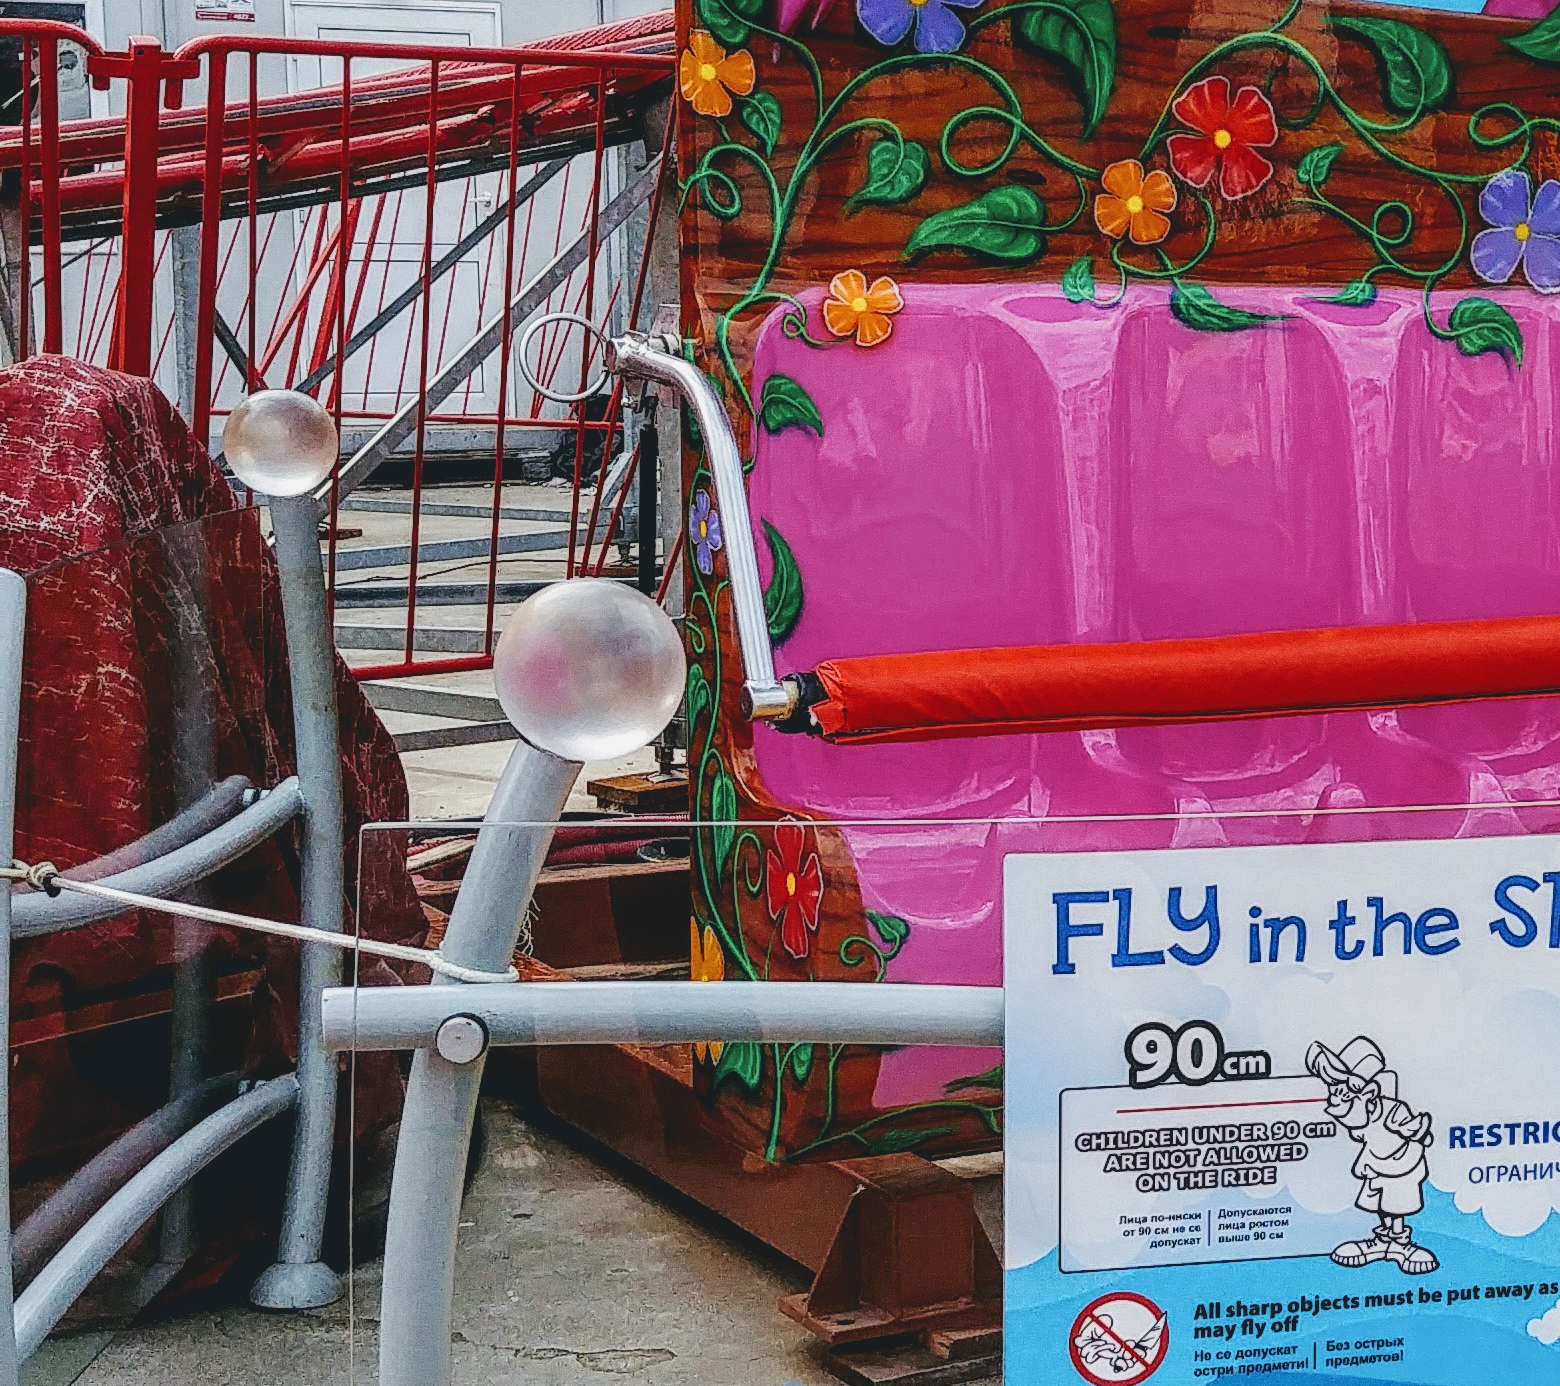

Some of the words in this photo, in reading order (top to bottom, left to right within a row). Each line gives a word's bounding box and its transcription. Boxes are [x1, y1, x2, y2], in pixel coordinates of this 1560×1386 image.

[1248, 905, 1307, 963] in
[1329, 897, 1461, 961] the
[1125, 1020, 1224, 1089] 90
[1220, 1050, 1271, 1078] cm
[1075, 1126, 1187, 1152] CHILDREN
[1192, 1123, 1269, 1145] UNDER
[1271, 1120, 1300, 1140] 90
[1303, 1122, 1336, 1138] cm
[1103, 1153, 1149, 1172] ARE
[1153, 1149, 1201, 1169] NOT
[1203, 1143, 1308, 1167] ALLOWED
[1136, 1173, 1171, 1192] ON
[1173, 1170, 1218, 1190] THE
[1221, 1167, 1277, 1187] RIDE
[1119, 1215, 1148, 1225] Лица
[1218, 1206, 1292, 1220] Допускаются
[1123, 1229, 1135, 1237] от
[1138, 1227, 1151, 1236] 90
[1154, 1227, 1169, 1235] см
[1218, 1222, 1245, 1231] лица
[1249, 1219, 1289, 1230] ростом
[1150, 1238, 1201, 1249] допускат
[1254, 1231, 1266, 1241] 90
[1194, 1302, 1221, 1320] All
[1226, 1301, 1283, 1319] sharp
[1288, 1295, 1360, 1316] objects
[1365, 1290, 1413, 1307] must
[1419, 1287, 1443, 1304] be
[1447, 1285, 1481, 1306] put
[1485, 1282, 1535, 1300] away
[1538, 1281, 1559, 1295] as
[1194, 1323, 1237, 1341] may
[1242, 1319, 1267, 1339] fly
[1271, 1315, 1299, 1332] off
[1326, 1340, 1350, 1352] Без
[1354, 1338, 1404, 1352] острых
[1235, 1345, 1299, 1361] допускат
[1194, 1366, 1234, 1379] остри
